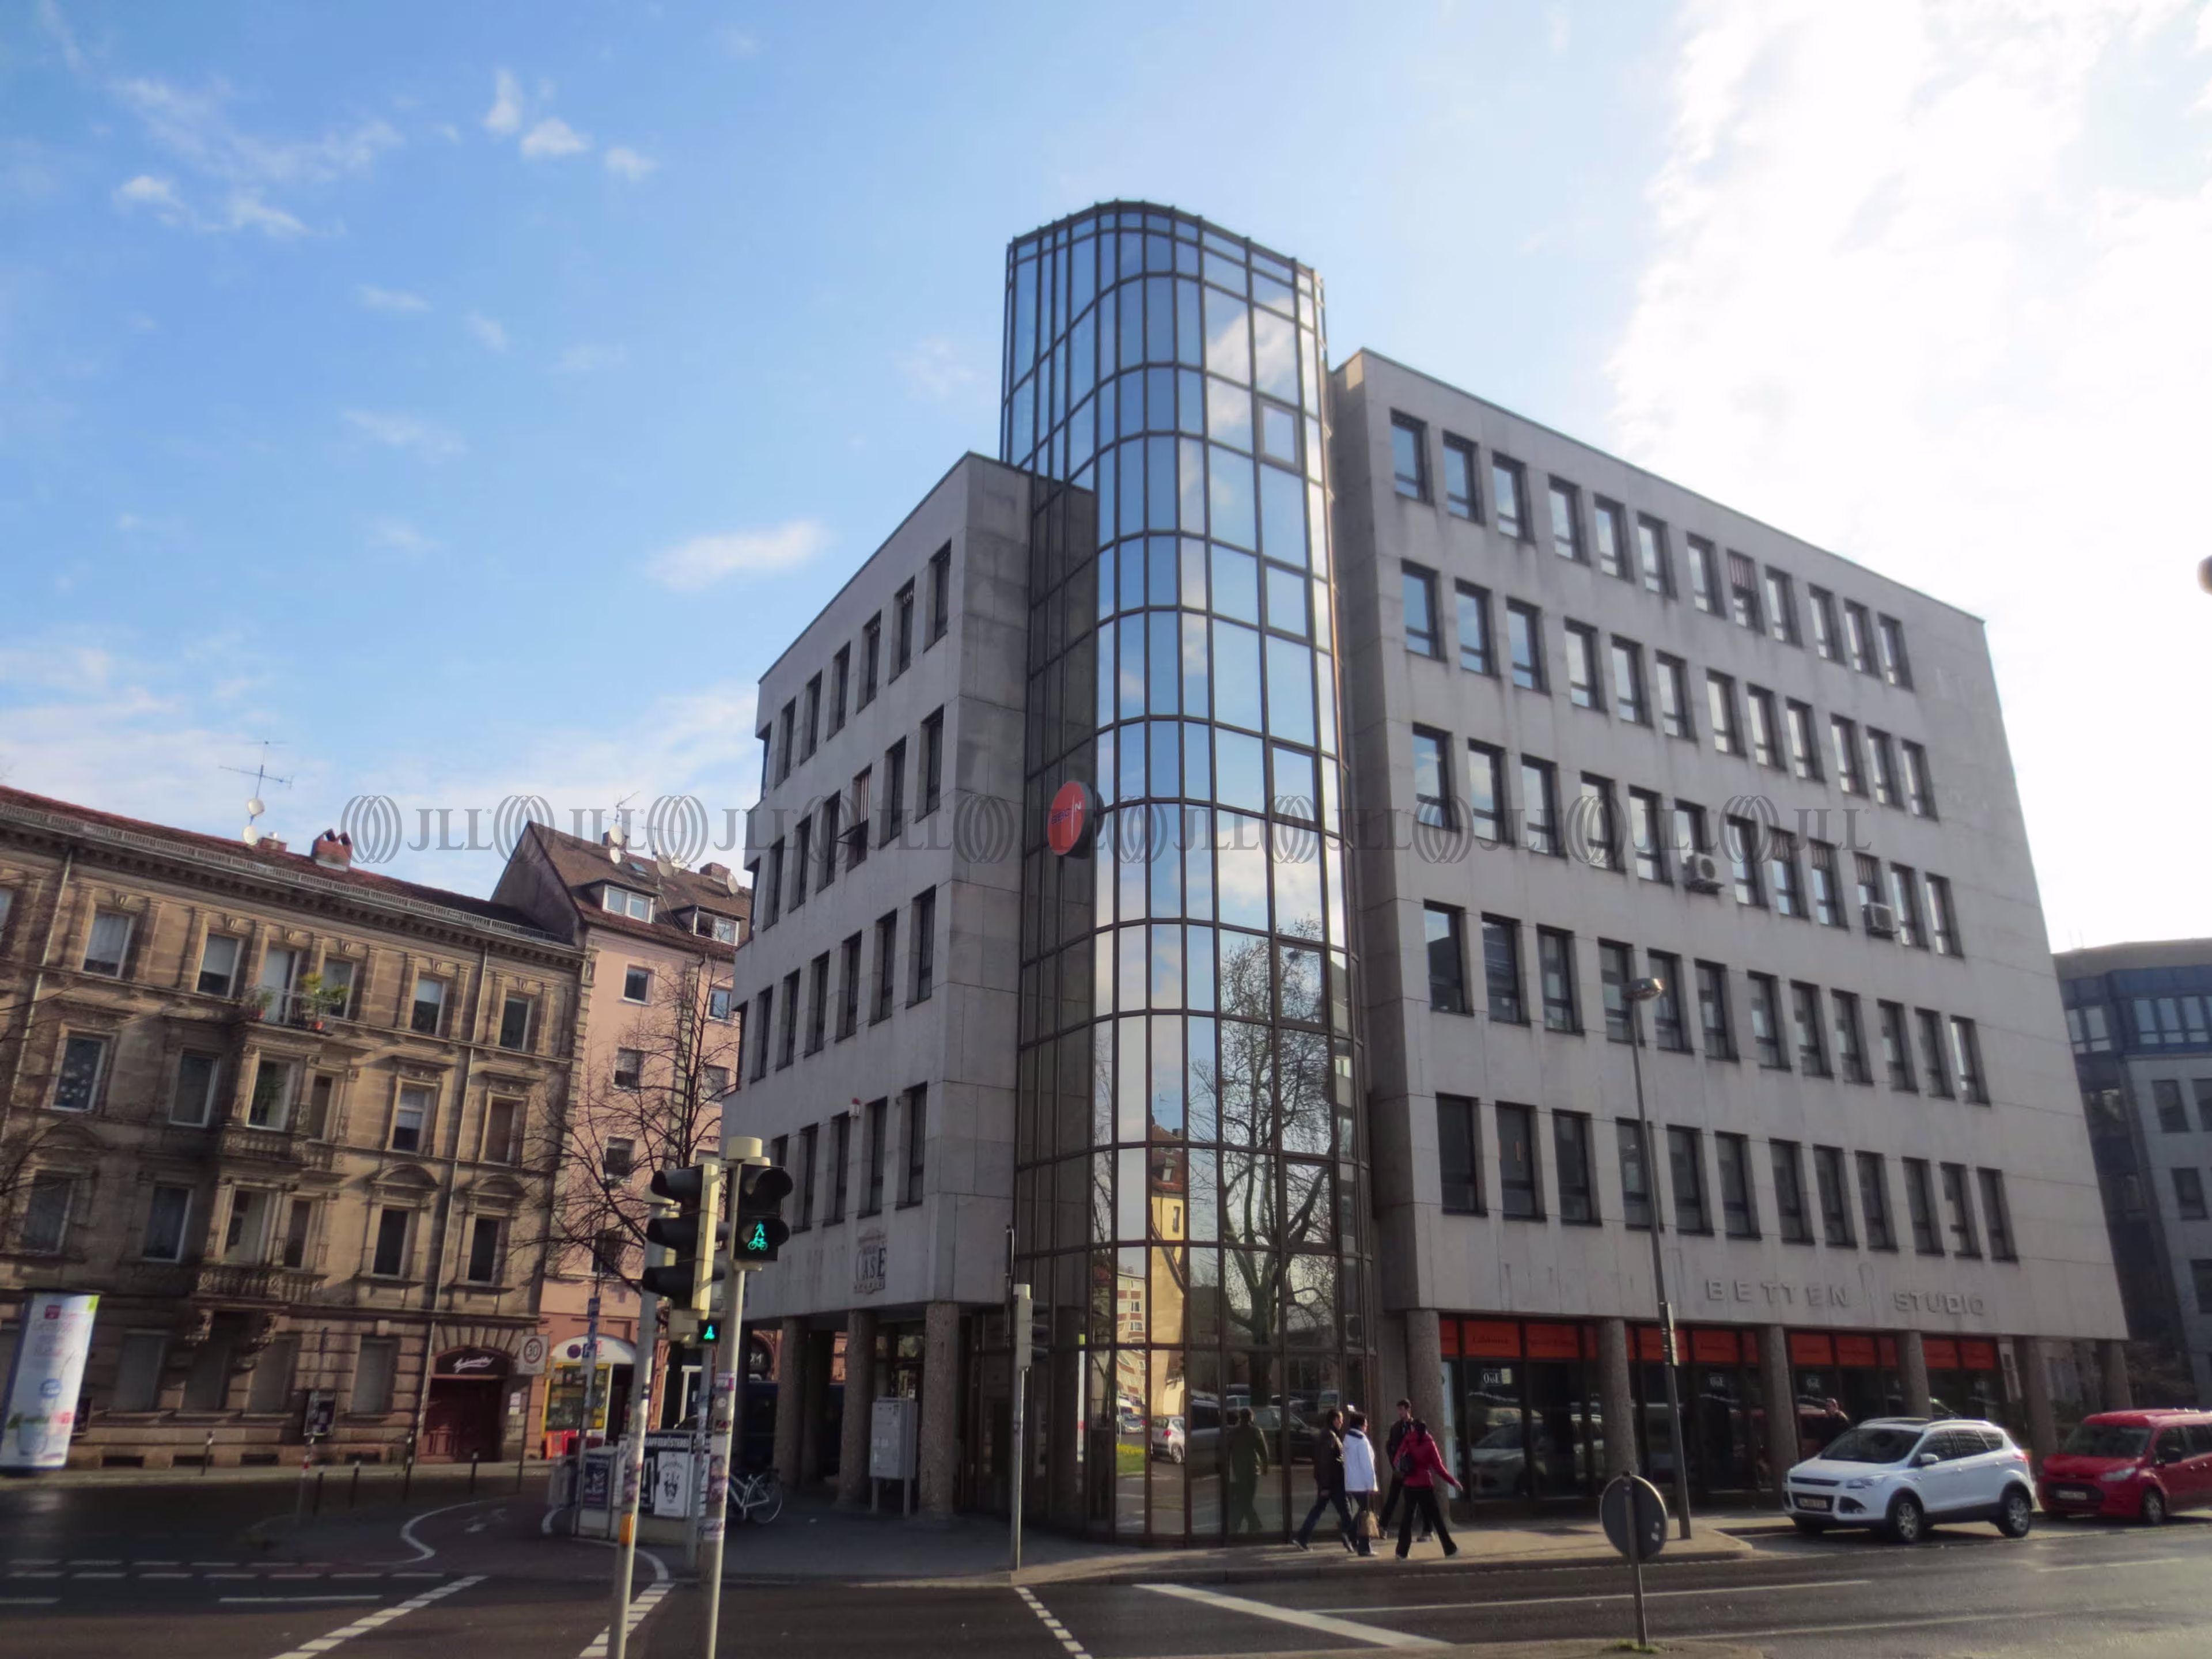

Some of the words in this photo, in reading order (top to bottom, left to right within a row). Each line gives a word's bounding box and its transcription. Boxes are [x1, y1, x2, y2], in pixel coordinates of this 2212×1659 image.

[1705, 1279, 1850, 1308] BETTEN
[1893, 1290, 1984, 1317] STUDIO
[527, 1344, 539, 1358] 30
